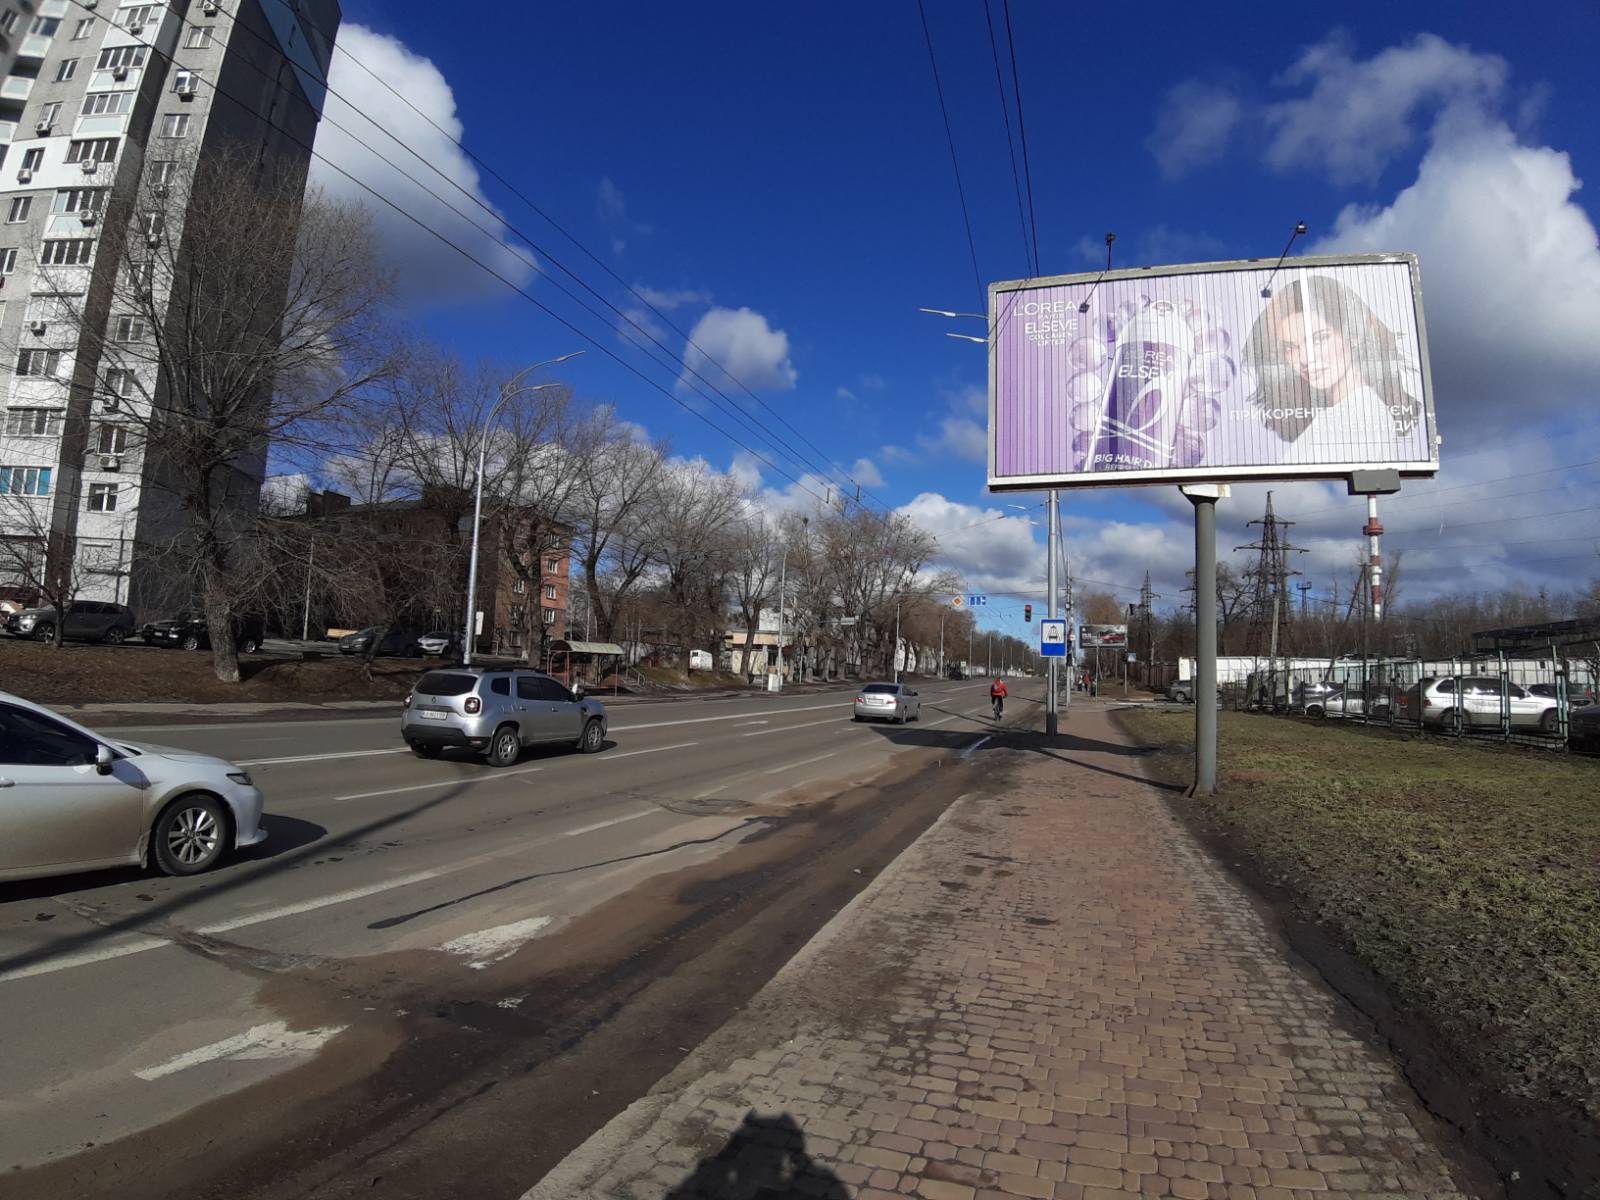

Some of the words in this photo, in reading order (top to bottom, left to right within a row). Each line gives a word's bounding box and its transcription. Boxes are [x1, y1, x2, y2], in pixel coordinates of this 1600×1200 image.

[1025, 319, 1078, 334] ELSEVE
[1094, 453, 1113, 463] BIG
[1115, 453, 1142, 466] HAIR
